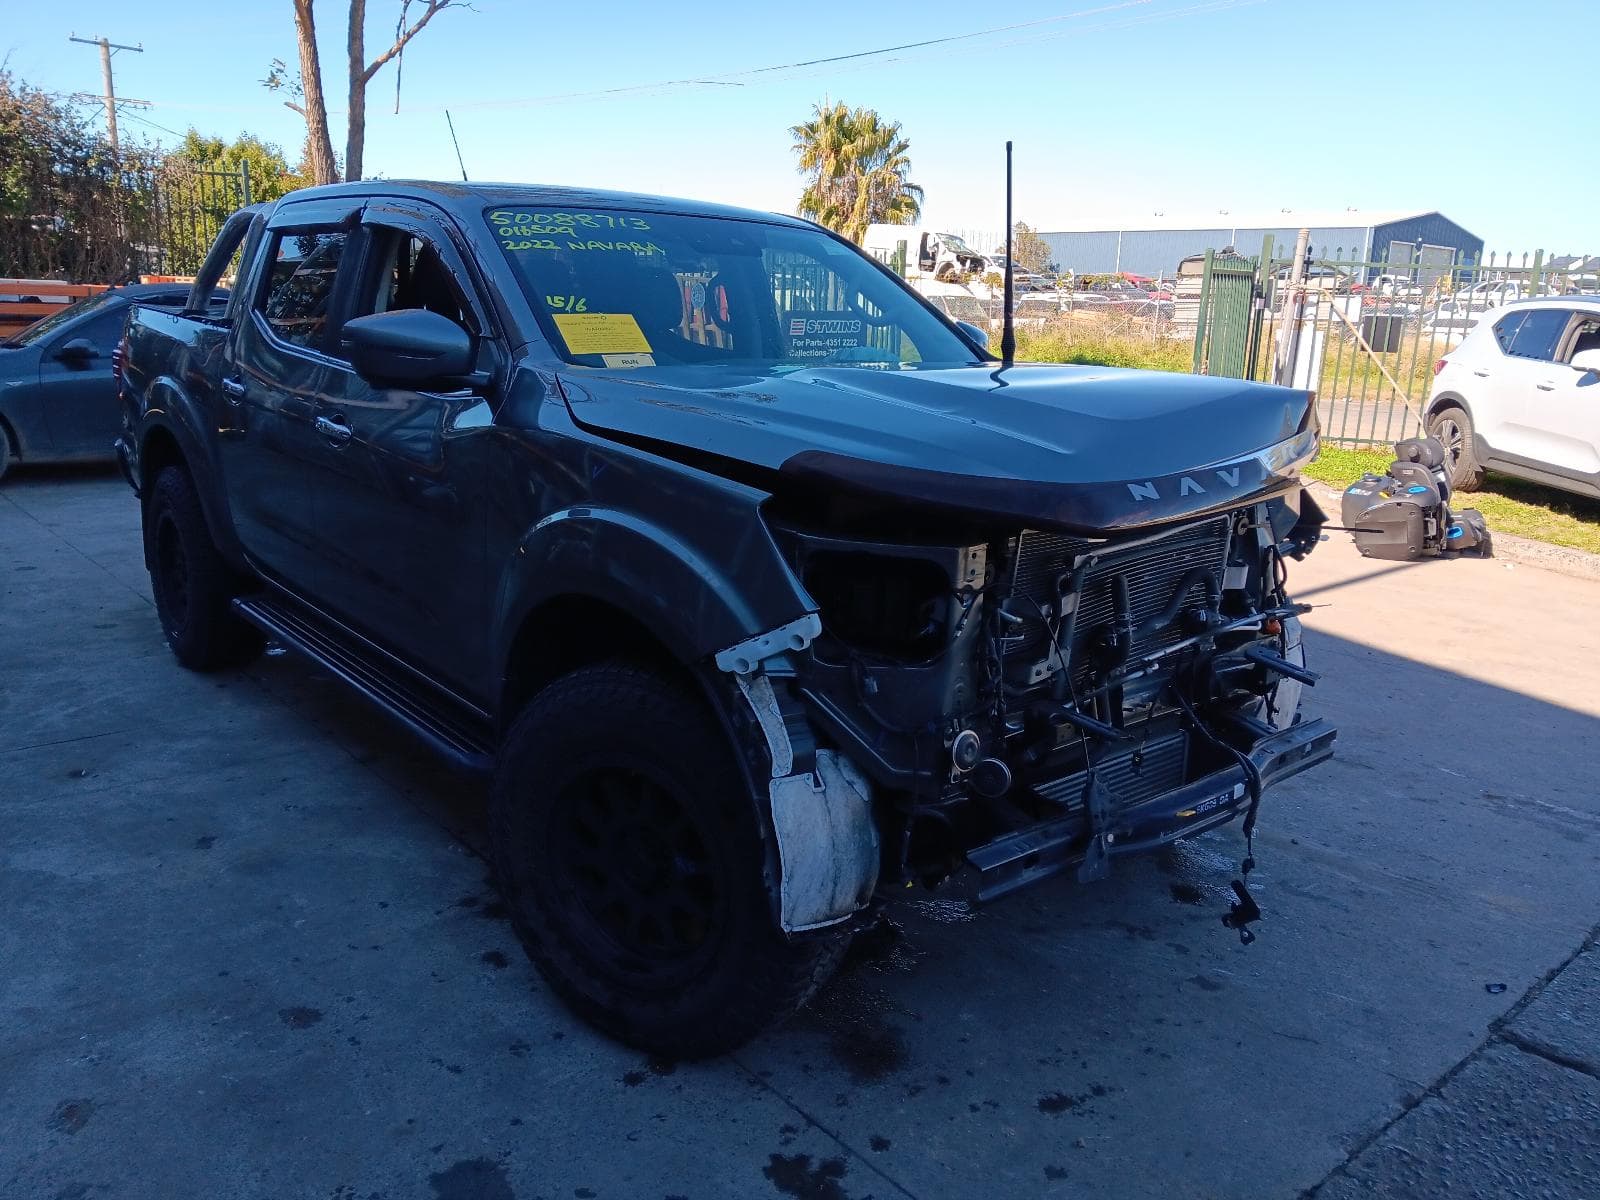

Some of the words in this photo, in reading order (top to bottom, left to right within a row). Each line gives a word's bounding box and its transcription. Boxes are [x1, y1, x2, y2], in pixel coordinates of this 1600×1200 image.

[490, 211, 650, 230] 50088713
[502, 240, 562, 250] 2022
[792, 338, 804, 347] For
[842, 338, 858, 347] 2222
